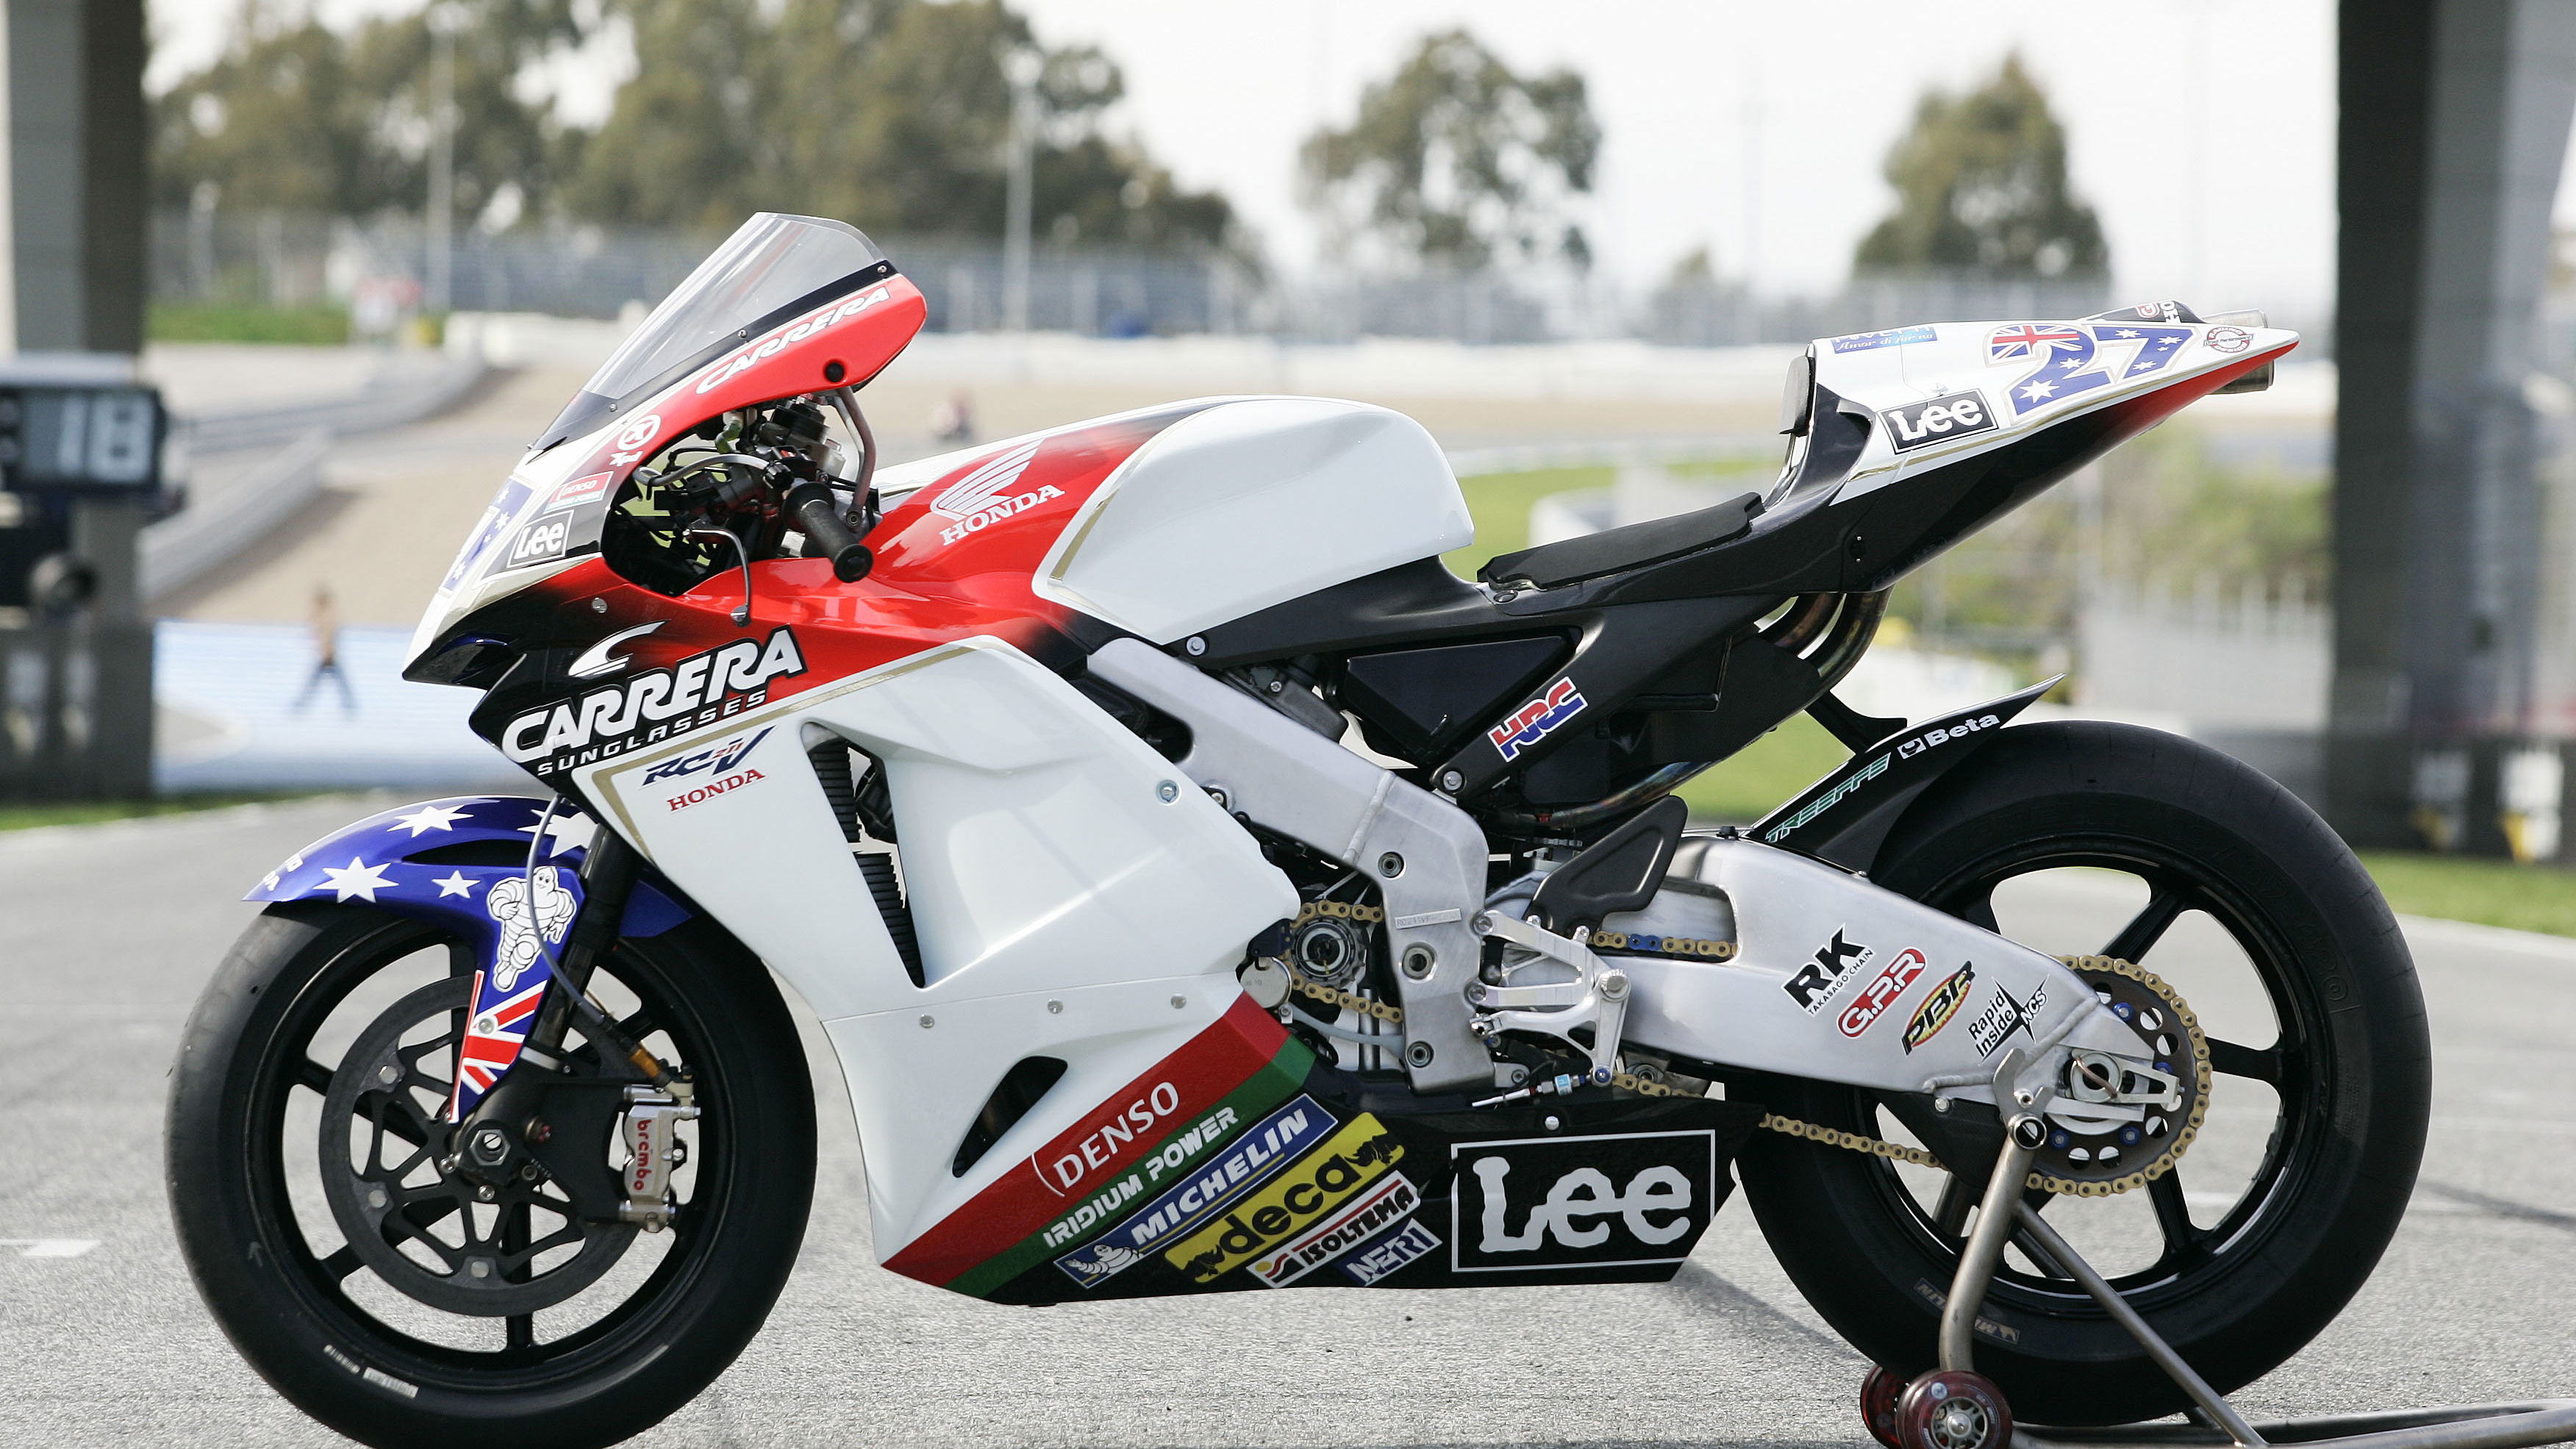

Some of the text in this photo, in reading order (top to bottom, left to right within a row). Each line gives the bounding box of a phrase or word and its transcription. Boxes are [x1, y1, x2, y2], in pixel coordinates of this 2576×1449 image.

[695, 286, 891, 395] CARRERA
[1988, 325, 2195, 423] 27
[1887, 398, 1983, 442] Lee
[513, 522, 565, 559] Lee
[939, 484, 1065, 546] HONDA
[502, 629, 804, 764] CARRERA
[537, 690, 766, 776] SUNGLASSES
[1487, 676, 1588, 762] HRC
[1924, 714, 2000, 747] Beta
[666, 768, 765, 812] HONDA
[1783, 927, 1866, 1009] RK
[1808, 948, 1874, 1015] TAKASAGO CHAIN
[2020, 990, 2047, 1025] NCS
[1968, 991, 2006, 1040] Rapid
[1975, 1009, 2014, 1057] Inside
[634, 1119, 653, 1191] brembo
[1053, 1081, 1179, 1189] DENSO
[1042, 1106, 1239, 1248] IRIDIUM POWER
[1131, 1108, 1309, 1245] MICHELIN
[1219, 1153, 1362, 1255] deca
[1473, 1156, 1692, 1253] Lee
[1299, 1184, 1415, 1266] ISOLTEMA
[1346, 1226, 1435, 1283] NERI
